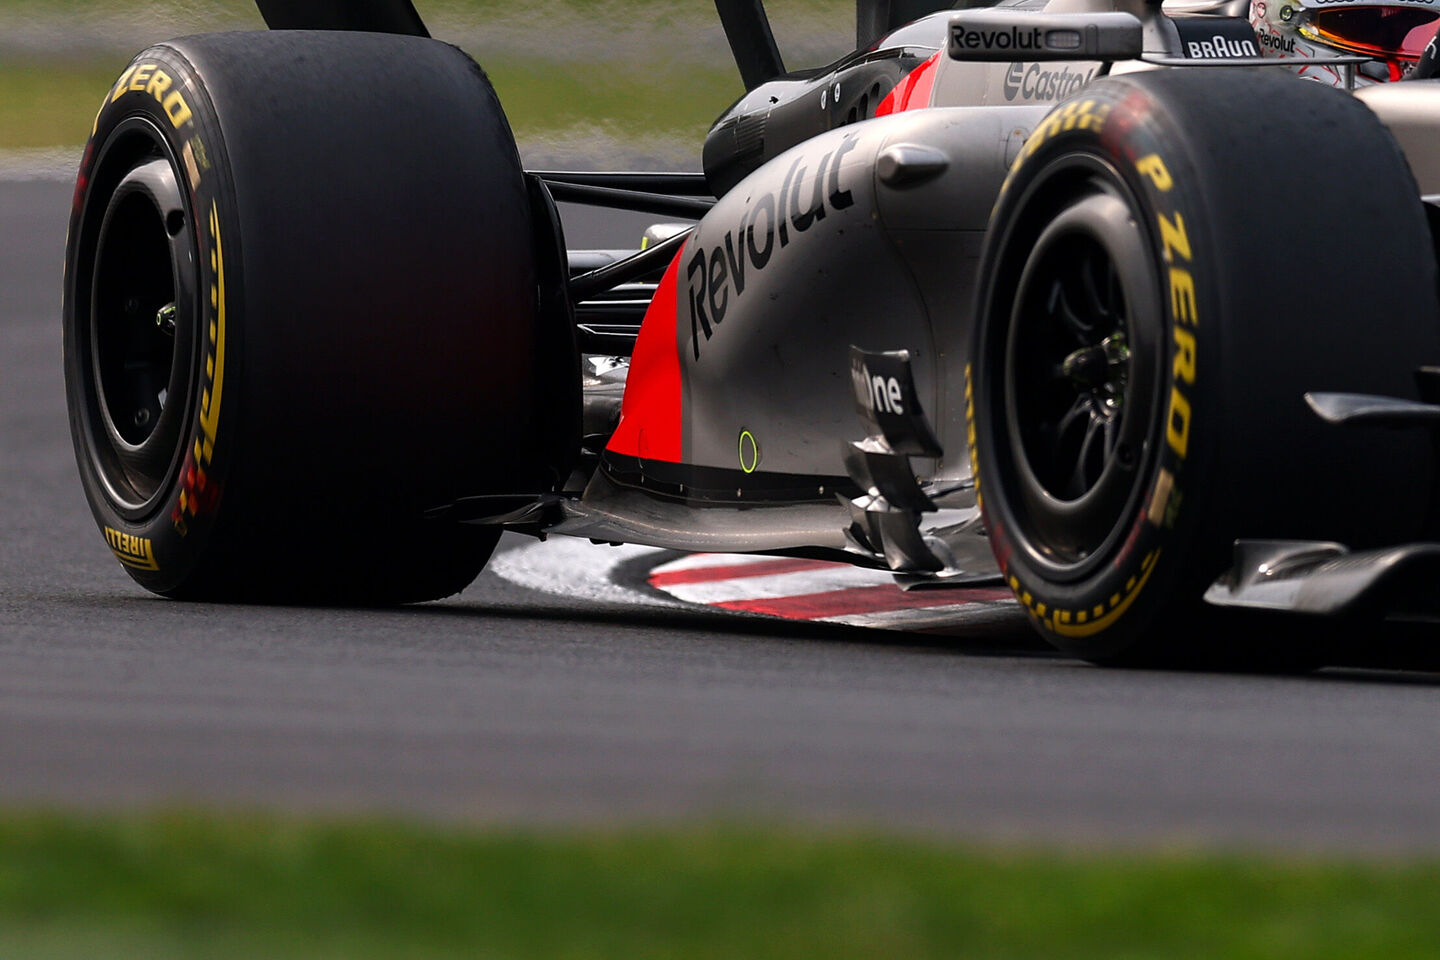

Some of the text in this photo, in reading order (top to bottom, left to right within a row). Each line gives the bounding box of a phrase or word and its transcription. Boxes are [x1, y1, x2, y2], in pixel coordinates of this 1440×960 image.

[951, 25, 1043, 51] Revolut
[1259, 28, 1296, 54] Revolut
[110, 64, 193, 130] ZERO
[686, 131, 859, 362] Revolut
[1135, 152, 1199, 460] P ZERO
[104, 526, 160, 571] PIRELLI
